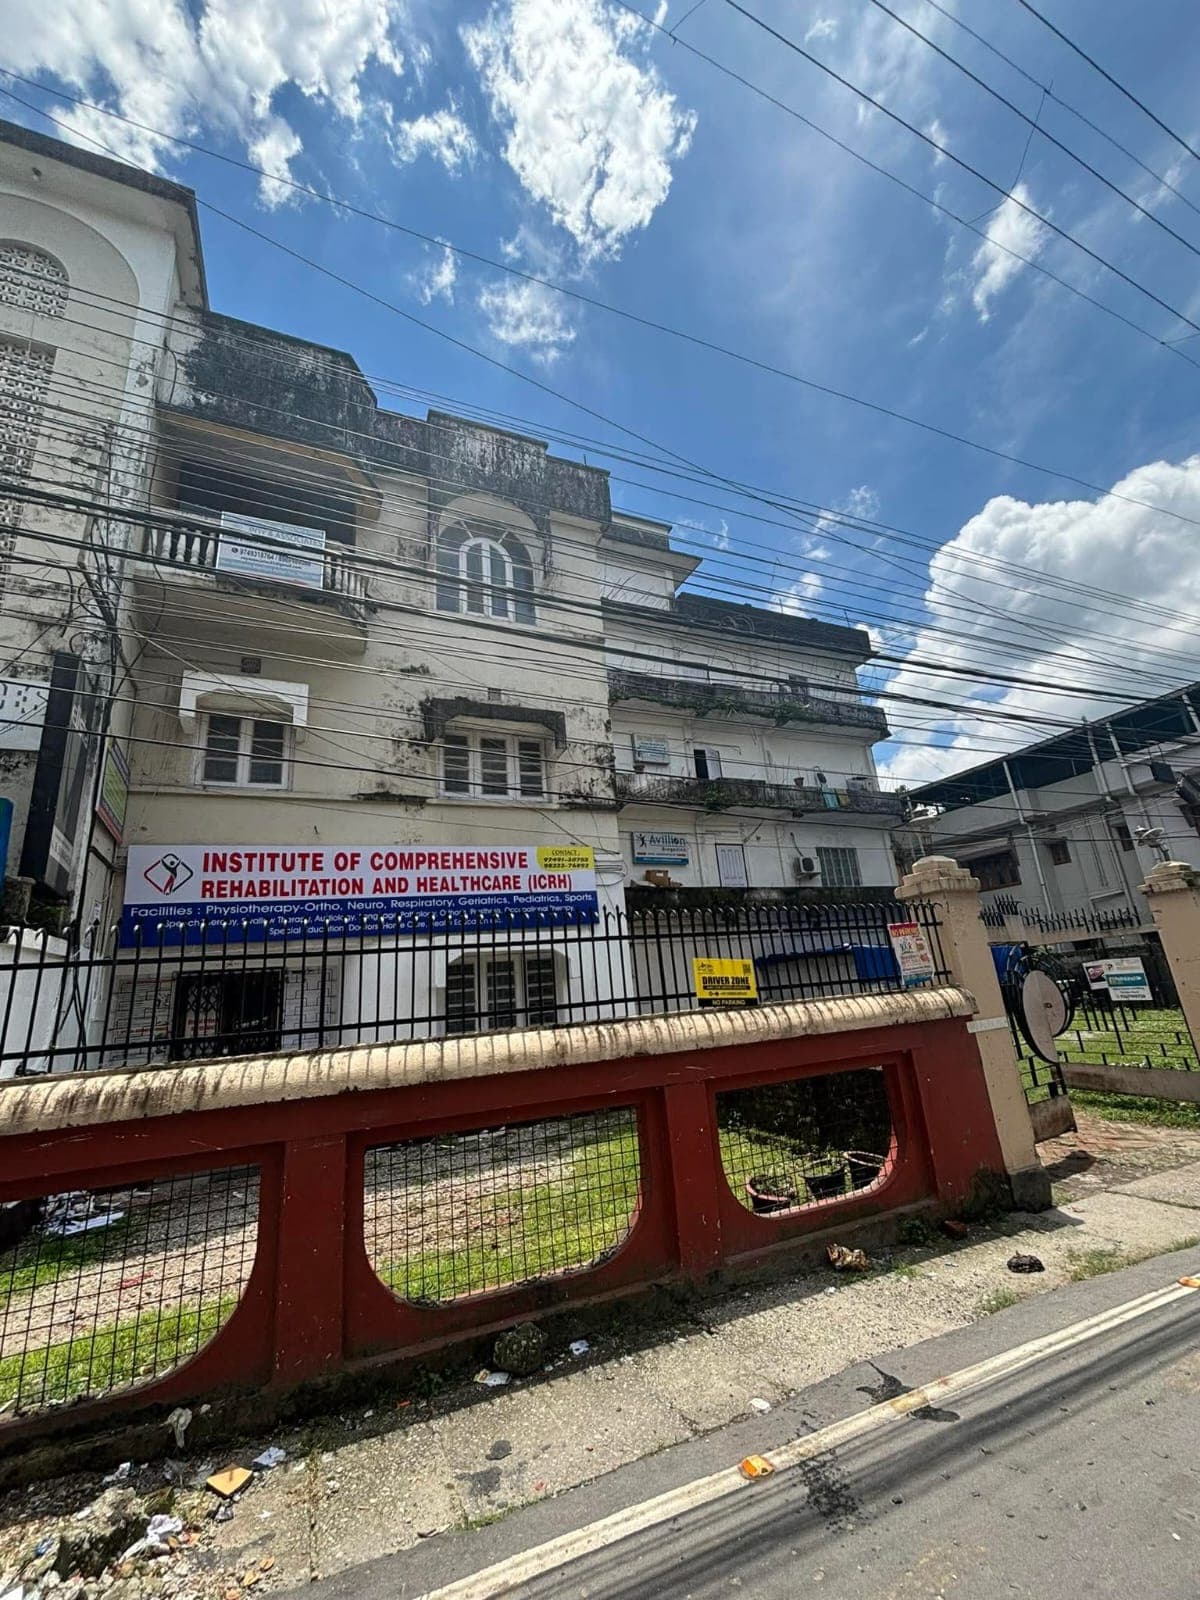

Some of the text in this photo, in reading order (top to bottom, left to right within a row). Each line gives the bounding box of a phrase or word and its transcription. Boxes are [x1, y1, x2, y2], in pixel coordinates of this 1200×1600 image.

[203, 851, 528, 872] INSTITUTE OF COMPREHENSIVE
[201, 873, 572, 898] REHABILITATION AND HEALTHCARE (ICRH)
[130, 906, 193, 917] Facilities
[702, 976, 750, 985] DRIVER ZONE
